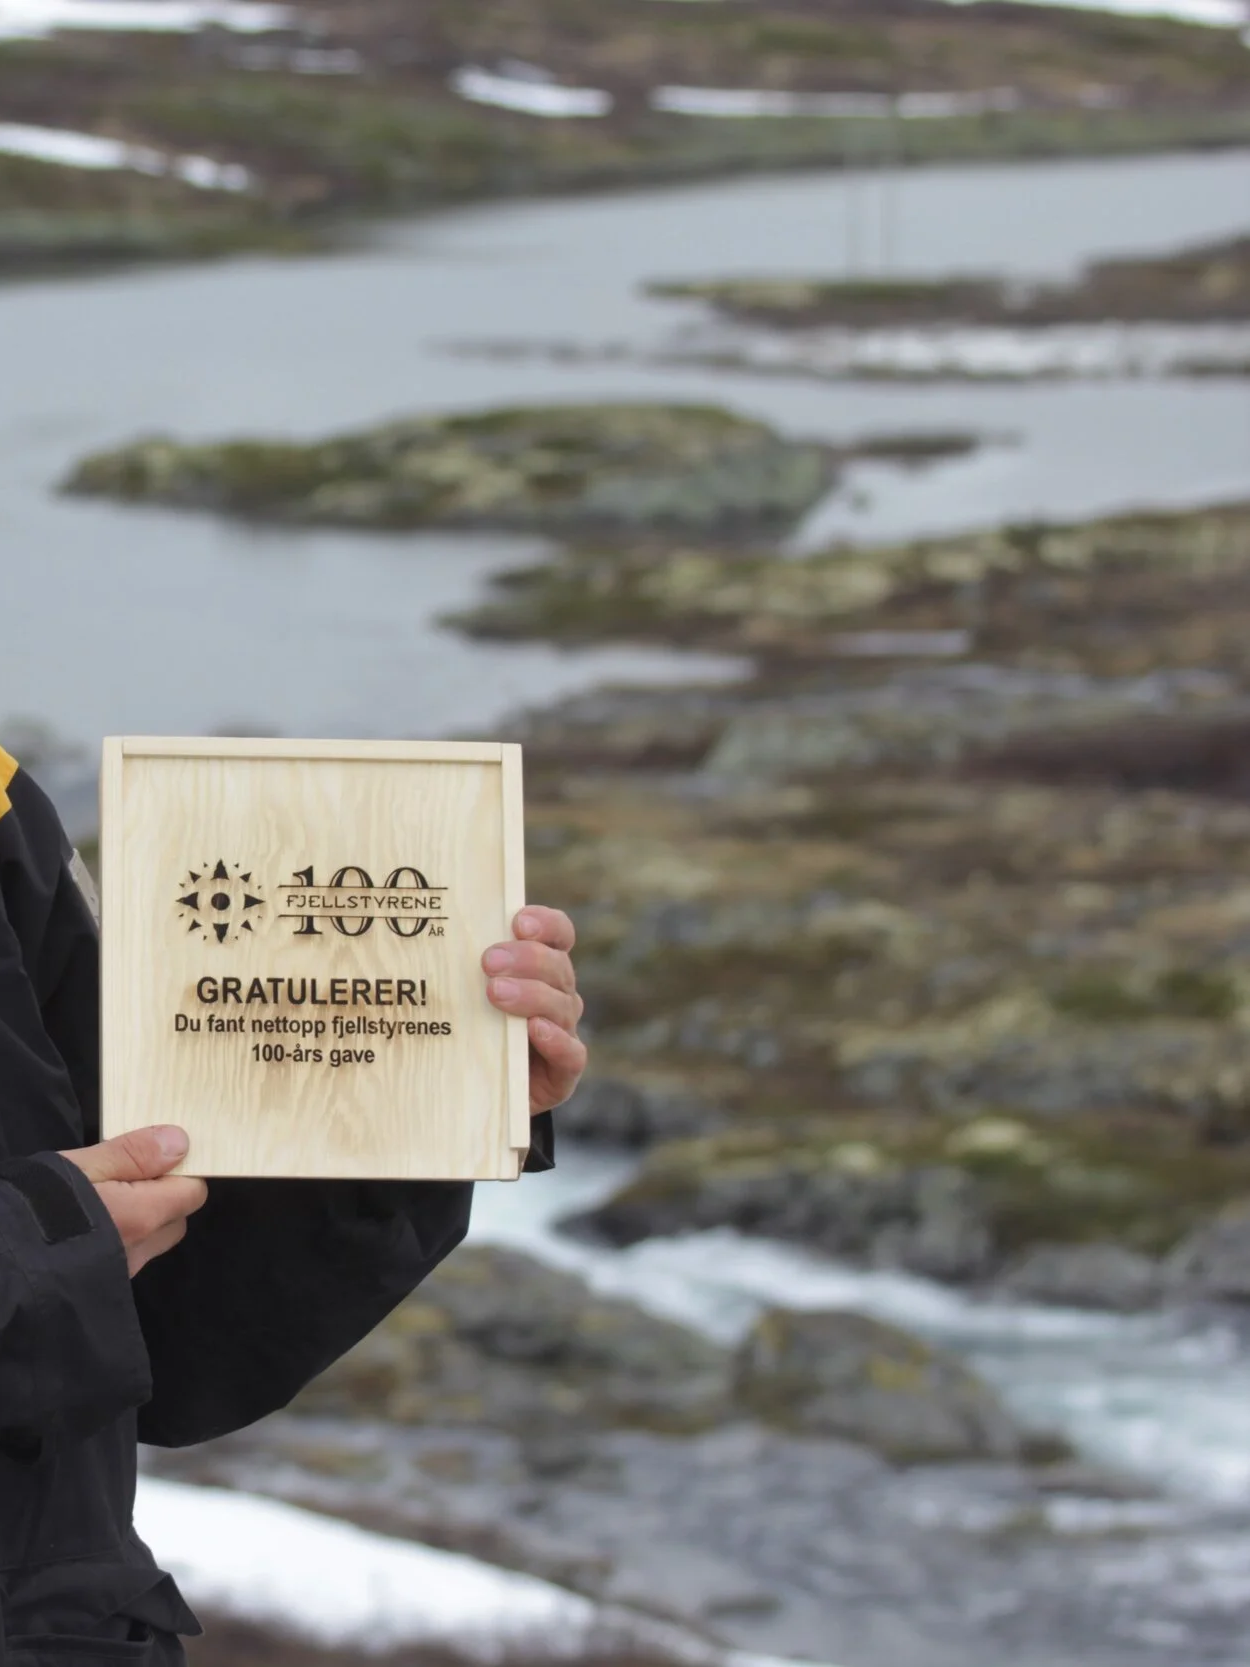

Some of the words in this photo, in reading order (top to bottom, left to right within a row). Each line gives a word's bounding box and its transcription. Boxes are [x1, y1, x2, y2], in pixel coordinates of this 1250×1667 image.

[286, 895, 442, 910] FJELLSTYRENE
[291, 865, 430, 938] 100
[428, 924, 445, 938] ÅR
[196, 976, 427, 1006] GRATULERER!
[174, 1014, 200, 1032] Du
[207, 1015, 245, 1032] fant
[251, 1016, 326, 1038] nettopp
[331, 1016, 452, 1039] fjellstyrenes
[252, 1043, 323, 1063] 100-års
[330, 1050, 375, 1067] gave
